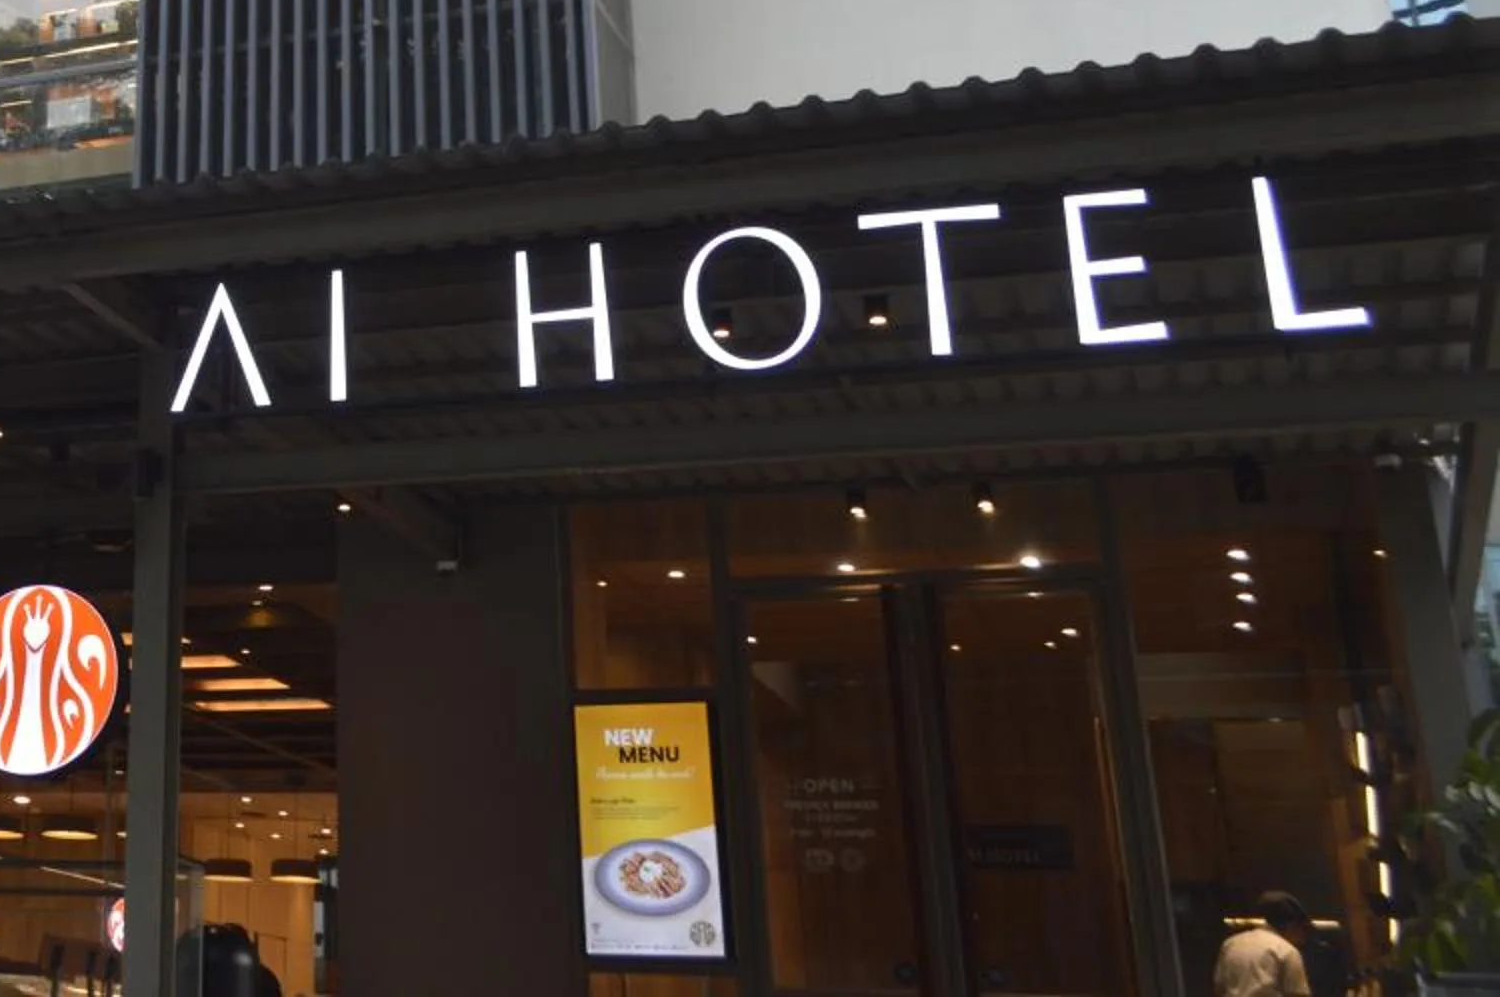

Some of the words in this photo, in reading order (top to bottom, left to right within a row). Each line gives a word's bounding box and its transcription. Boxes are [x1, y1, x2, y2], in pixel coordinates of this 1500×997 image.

[170, 269, 348, 412] AI
[514, 176, 1370, 388] HOTEL
[604, 728, 654, 746] NEW
[619, 745, 680, 763] MENU
